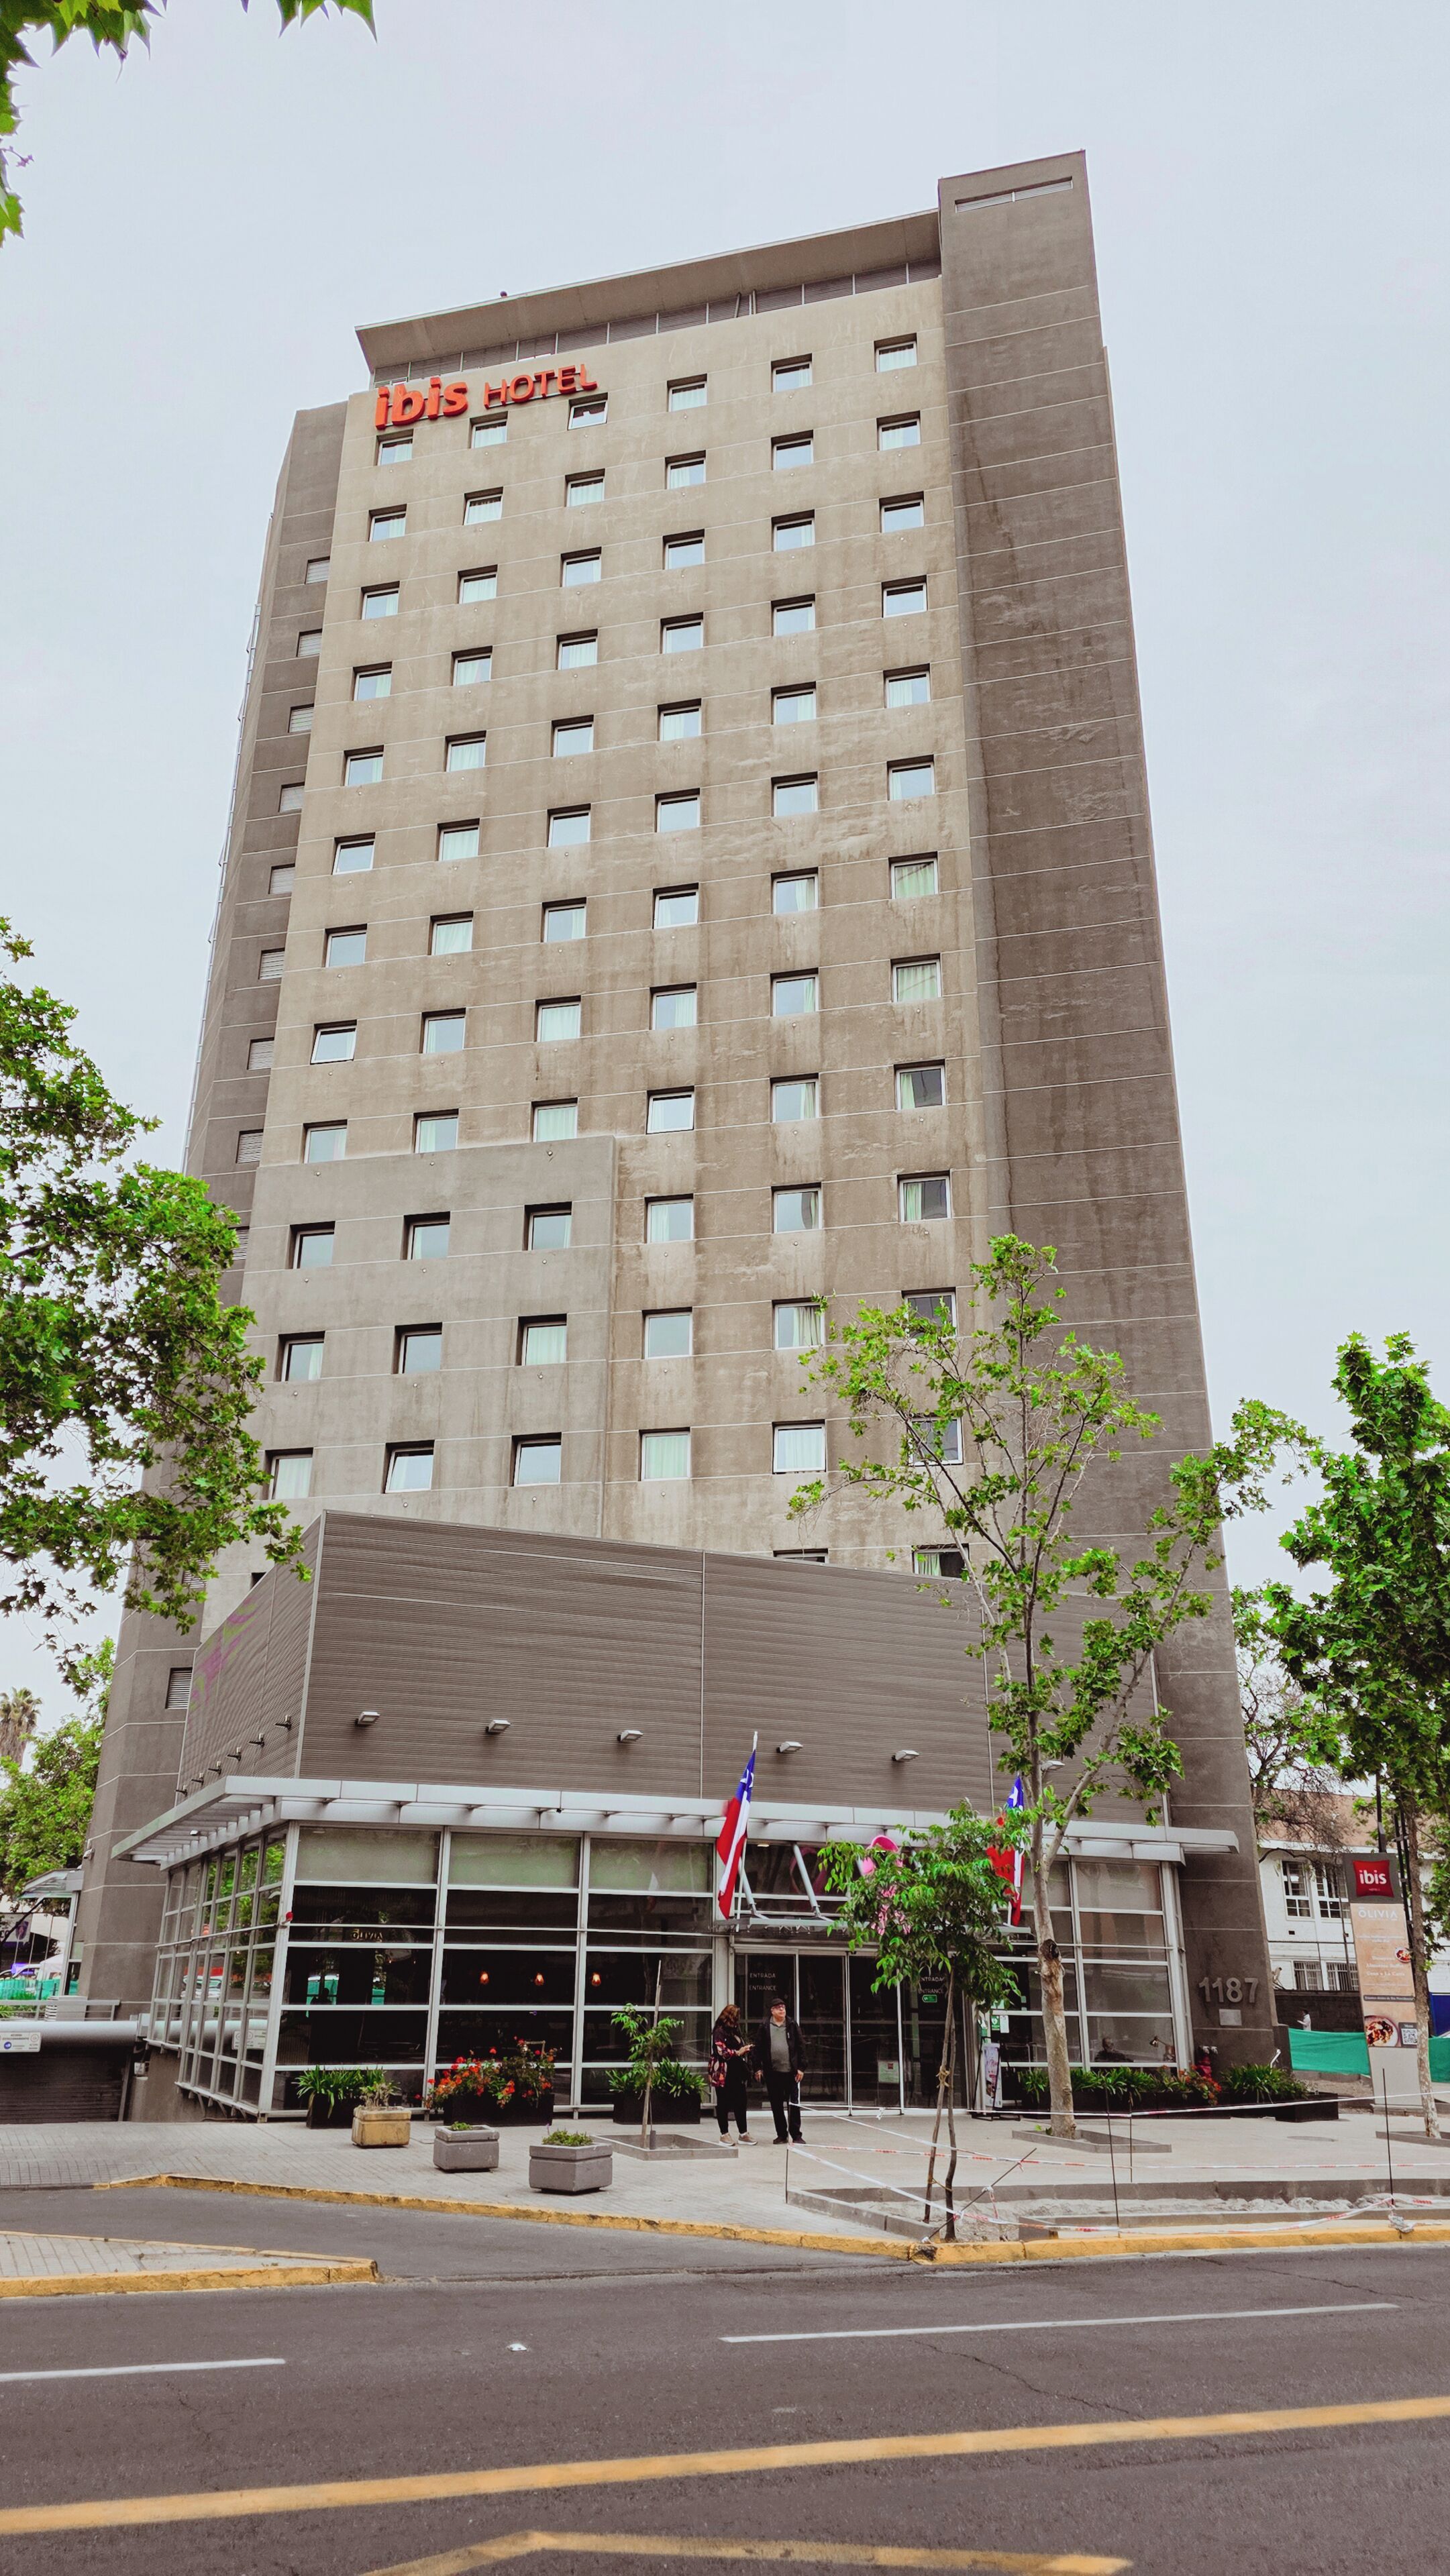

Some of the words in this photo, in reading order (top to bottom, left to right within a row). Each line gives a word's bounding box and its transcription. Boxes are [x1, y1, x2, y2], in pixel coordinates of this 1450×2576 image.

[375, 376, 468, 430] ibis
[483, 364, 598, 409] HOTEL
[1359, 1870, 1387, 1884] ibis
[1199, 1977, 1259, 2003] 1187
